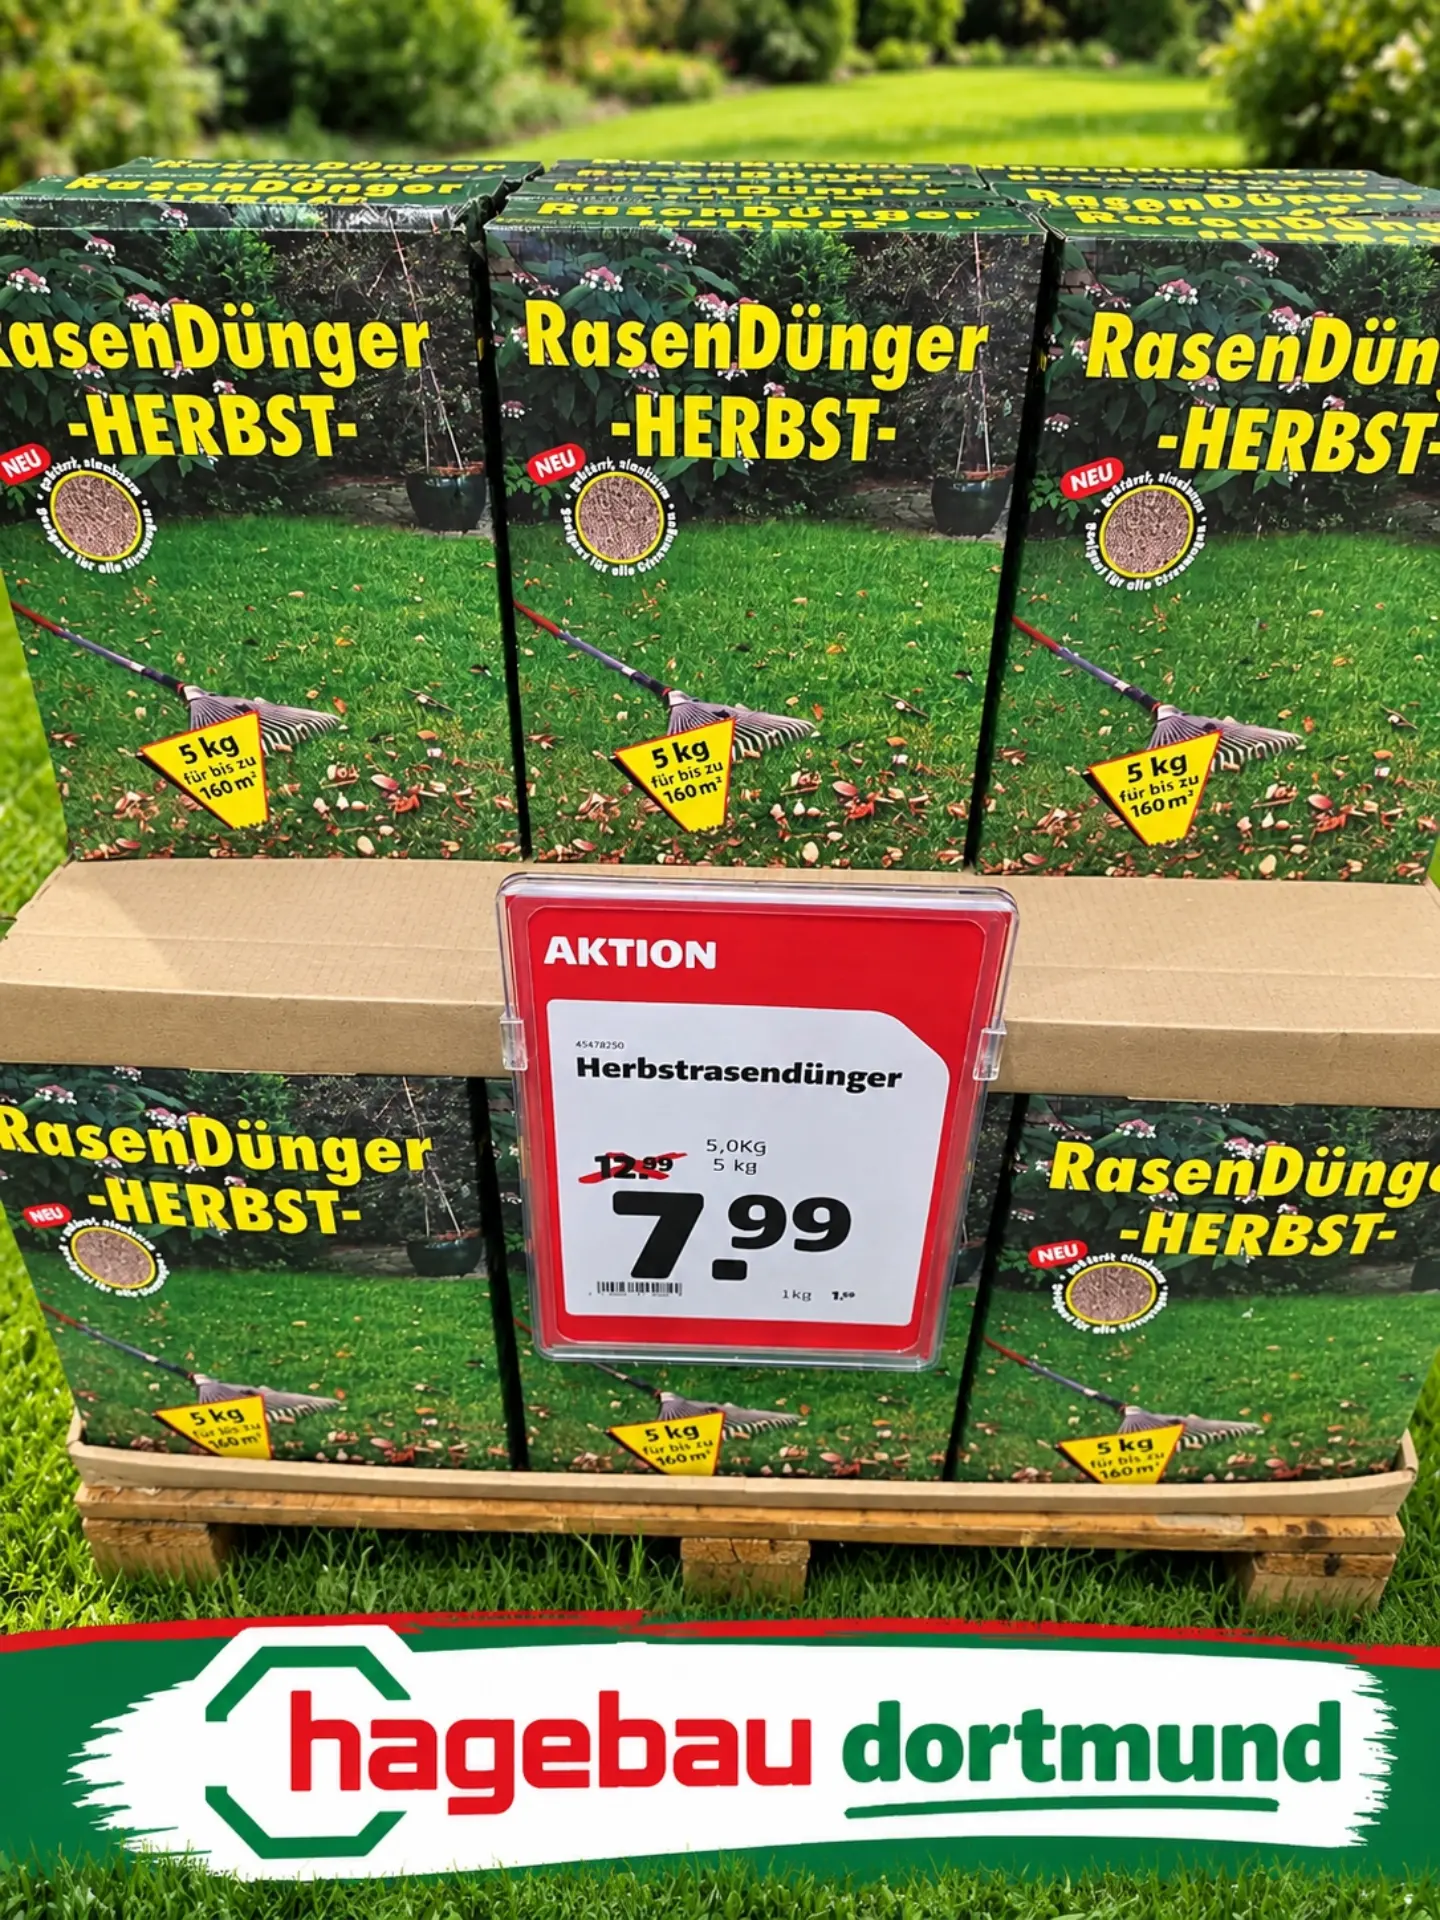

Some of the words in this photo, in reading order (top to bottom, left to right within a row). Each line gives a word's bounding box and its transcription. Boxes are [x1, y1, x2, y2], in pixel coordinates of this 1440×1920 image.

[0, 302, 429, 388] asenDünger
[525, 299, 989, 391] RasenDünger
[1086, 311, 1440, 402] RasenDün
[69, 394, 358, 458] -HERBST-
[610, 394, 896, 462] -HERBST-
[1, 448, 43, 479] NEU
[535, 448, 577, 479] NEU
[1070, 462, 1115, 493] NEU
[178, 743, 198, 765] 5
[198, 735, 240, 759] kg
[651, 747, 669, 769] 5
[672, 740, 710, 763] kg
[183, 770, 207, 785] für
[209, 762, 234, 778] bis
[236, 756, 257, 770] zu
[651, 773, 675, 789] für
[678, 765, 702, 781] bis
[705, 761, 724, 775] zu
[1127, 762, 1143, 783] 5
[1150, 754, 1188, 776] kg
[199, 779, 234, 800] 160
[663, 784, 698, 804] 160
[1119, 787, 1145, 803] für
[1150, 780, 1174, 796] bis
[1179, 775, 1199, 788] zu
[1130, 798, 1165, 818] 160
[543, 935, 717, 970] AKTION
[576, 1055, 903, 1095] Herbstrasendünger
[0, 1104, 433, 1186] RasenDünger
[594, 1154, 674, 1180] 12.99
[713, 1158, 725, 1172] 5
[734, 1159, 757, 1176] kg
[29, 1207, 64, 1223] NEU
[88, 1176, 362, 1235] -HERBST-
[612, 1190, 852, 1281] 7.99
[1119, 1211, 1397, 1258] -HERBST-
[1037, 1243, 1079, 1263] NEU
[190, 1411, 206, 1426] 5
[208, 1408, 245, 1423] kg
[645, 1428, 659, 1442] 5
[664, 1425, 700, 1440] kg
[1097, 1441, 1112, 1455] 5
[1118, 1437, 1154, 1453] kg
